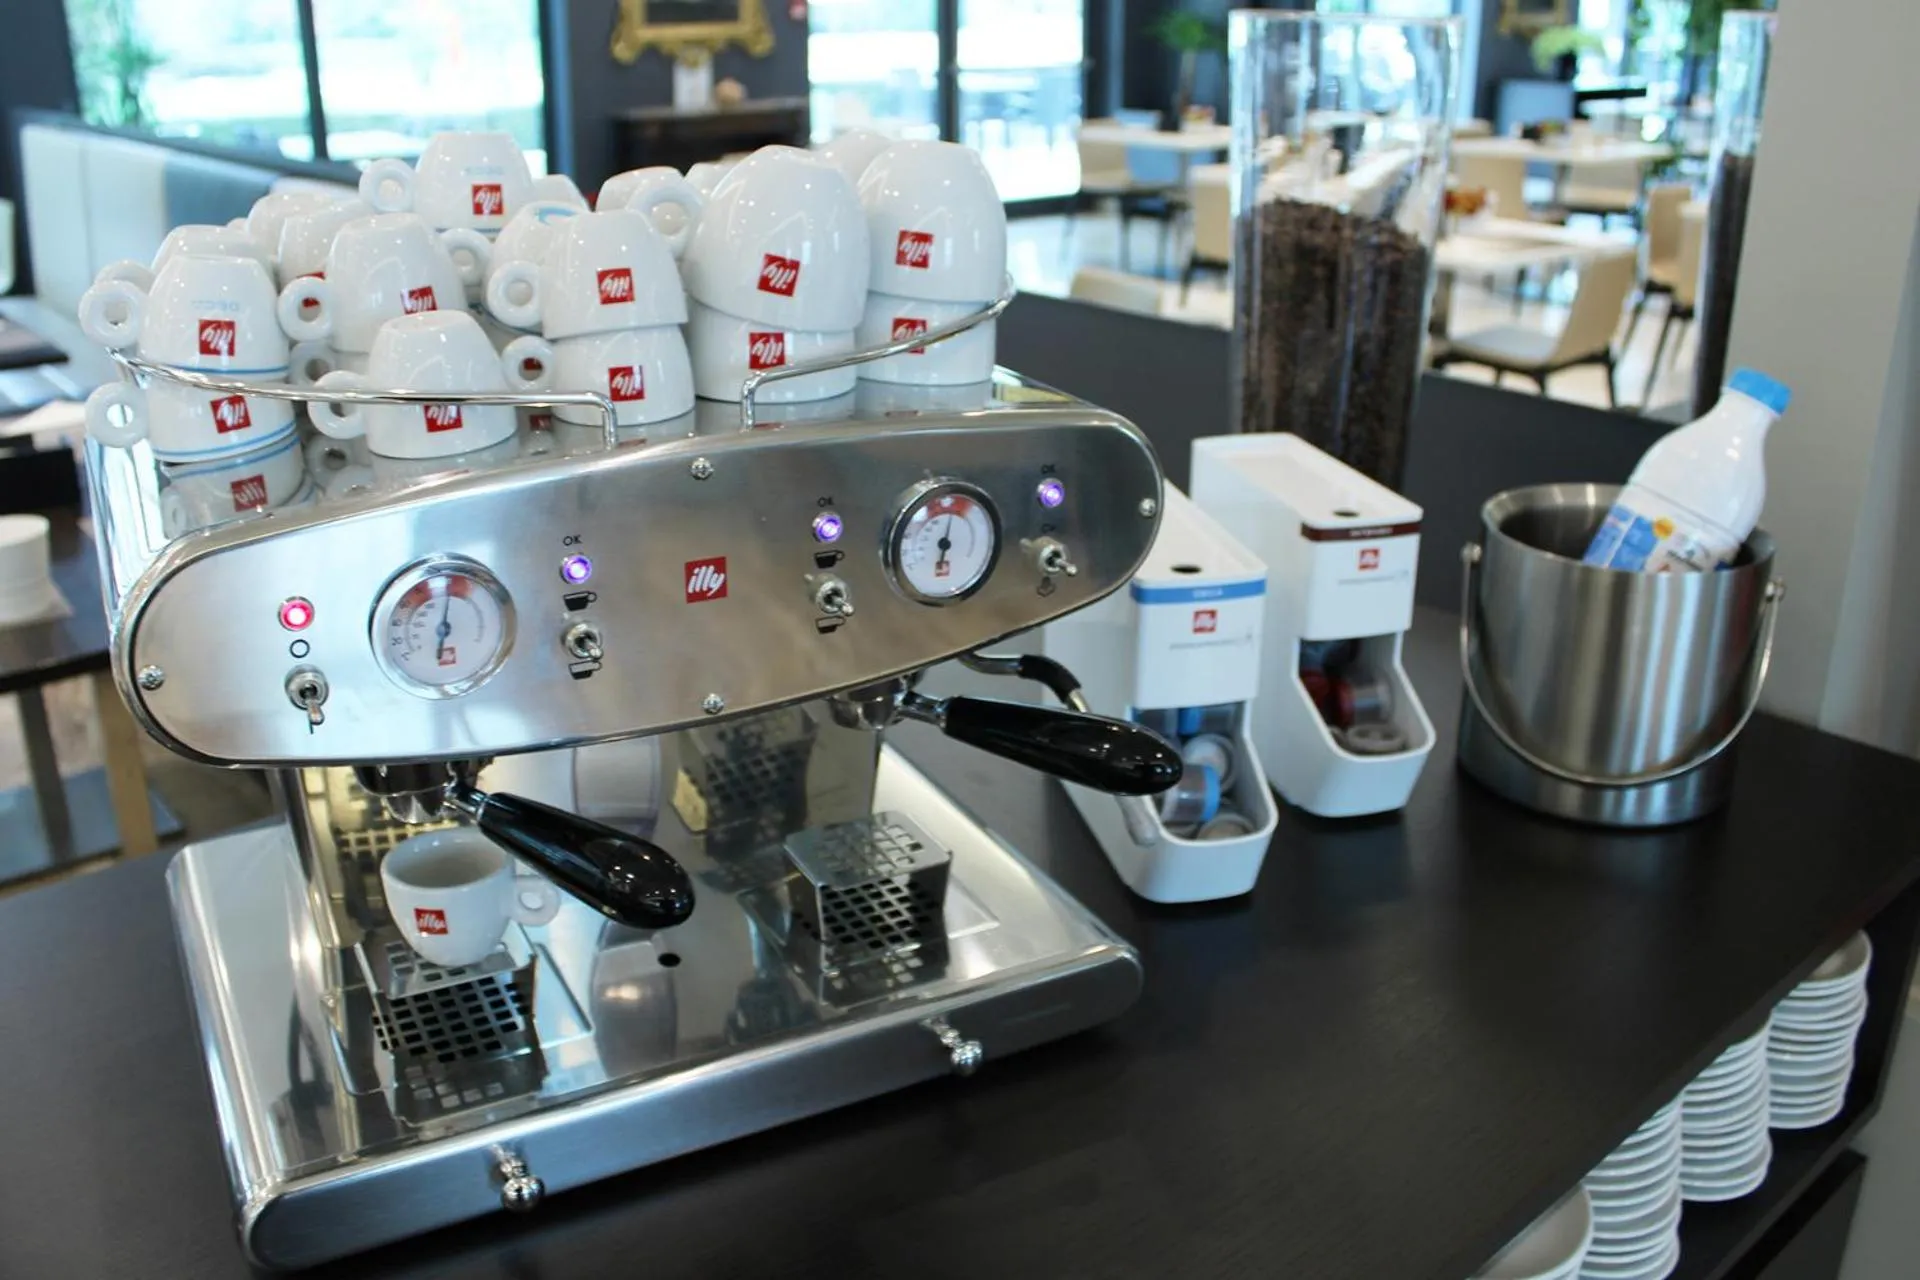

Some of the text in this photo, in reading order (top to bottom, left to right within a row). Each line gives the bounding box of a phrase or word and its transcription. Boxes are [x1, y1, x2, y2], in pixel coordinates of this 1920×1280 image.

[474, 187, 500, 212] illy
[900, 236, 929, 263] illy
[601, 271, 631, 299] illy
[763, 259, 795, 290] illy
[200, 322, 233, 351] illy
[751, 337, 783, 365] illy
[817, 496, 835, 508] OK
[562, 533, 582, 546] OK
[687, 564, 725, 598] illy
[417, 912, 447, 932] illy
